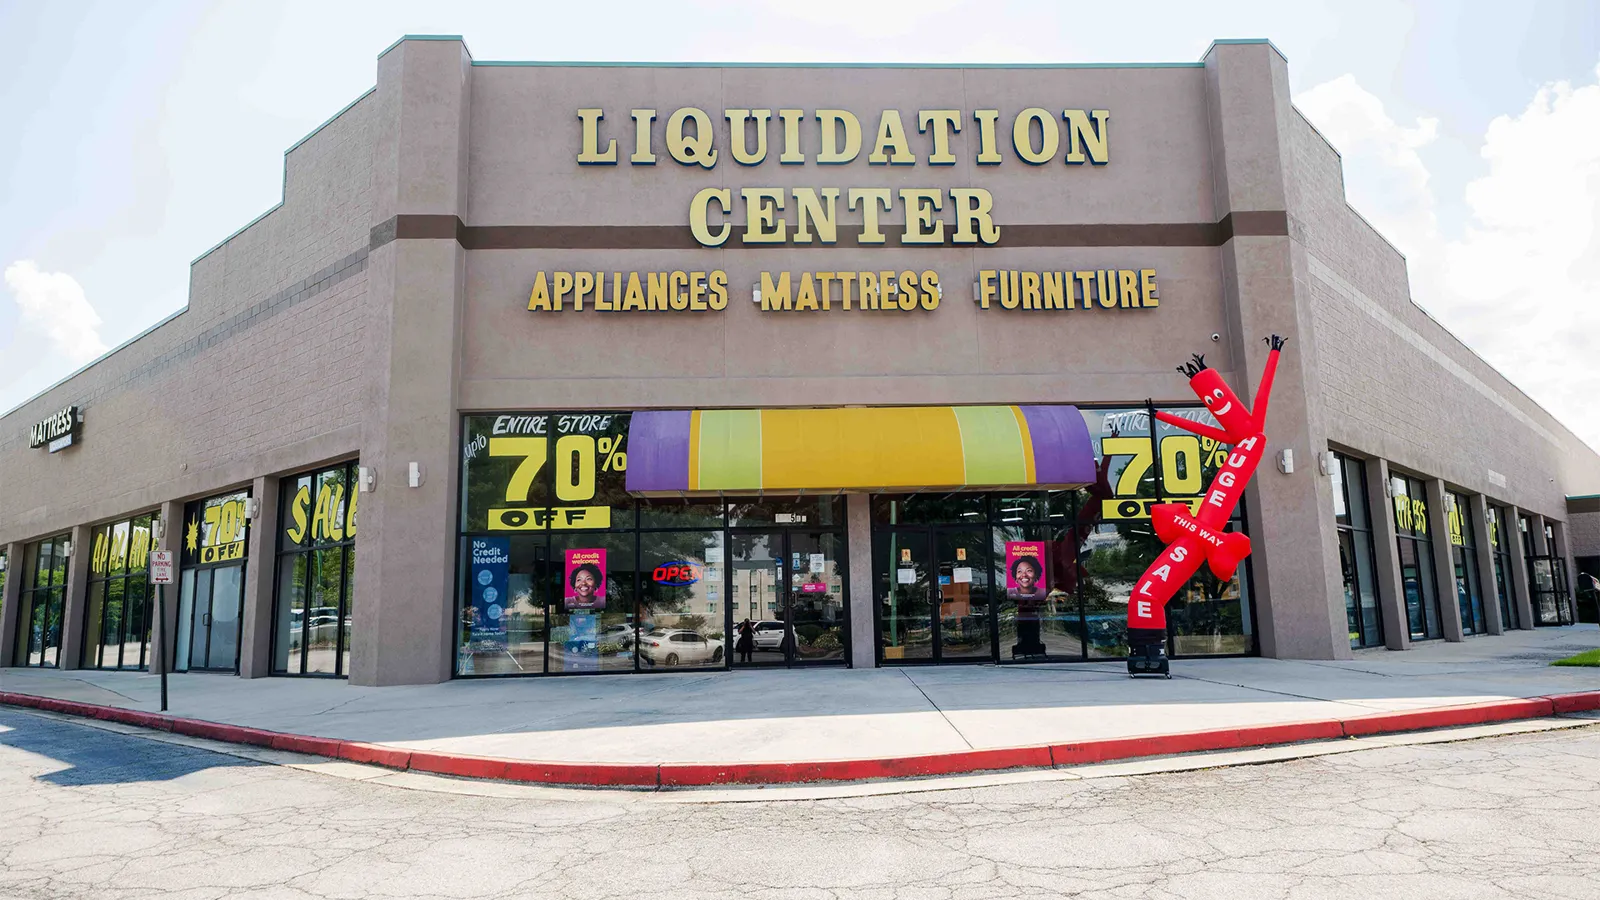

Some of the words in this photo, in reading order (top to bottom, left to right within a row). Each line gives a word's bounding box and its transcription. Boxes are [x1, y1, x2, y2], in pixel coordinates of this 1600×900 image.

[577, 107, 1110, 170] LIQUIDATION
[689, 187, 1001, 247] CENTER
[528, 270, 729, 312] APPLIANCES
[760, 271, 941, 312] MATTRESS
[977, 269, 1160, 310] FURNITURE
[29, 405, 72, 449] MATTRESS
[492, 415, 549, 435] ENTIRE
[557, 415, 612, 433] STORE
[489, 433, 628, 502] 70%
[1101, 435, 1229, 495] 70%
[1208, 436, 1258, 508] HUGE
[500, 510, 587, 527] OFF
[1173, 515, 1197, 532] THIS
[1199, 529, 1224, 547] WAY
[93, 529, 159, 573] APPLIAN
[472, 547, 501, 557] Credit
[473, 540, 487, 549] No
[473, 555, 508, 564] Needed
[652, 565, 704, 581] OPEN
[1137, 546, 1188, 618] SALE
